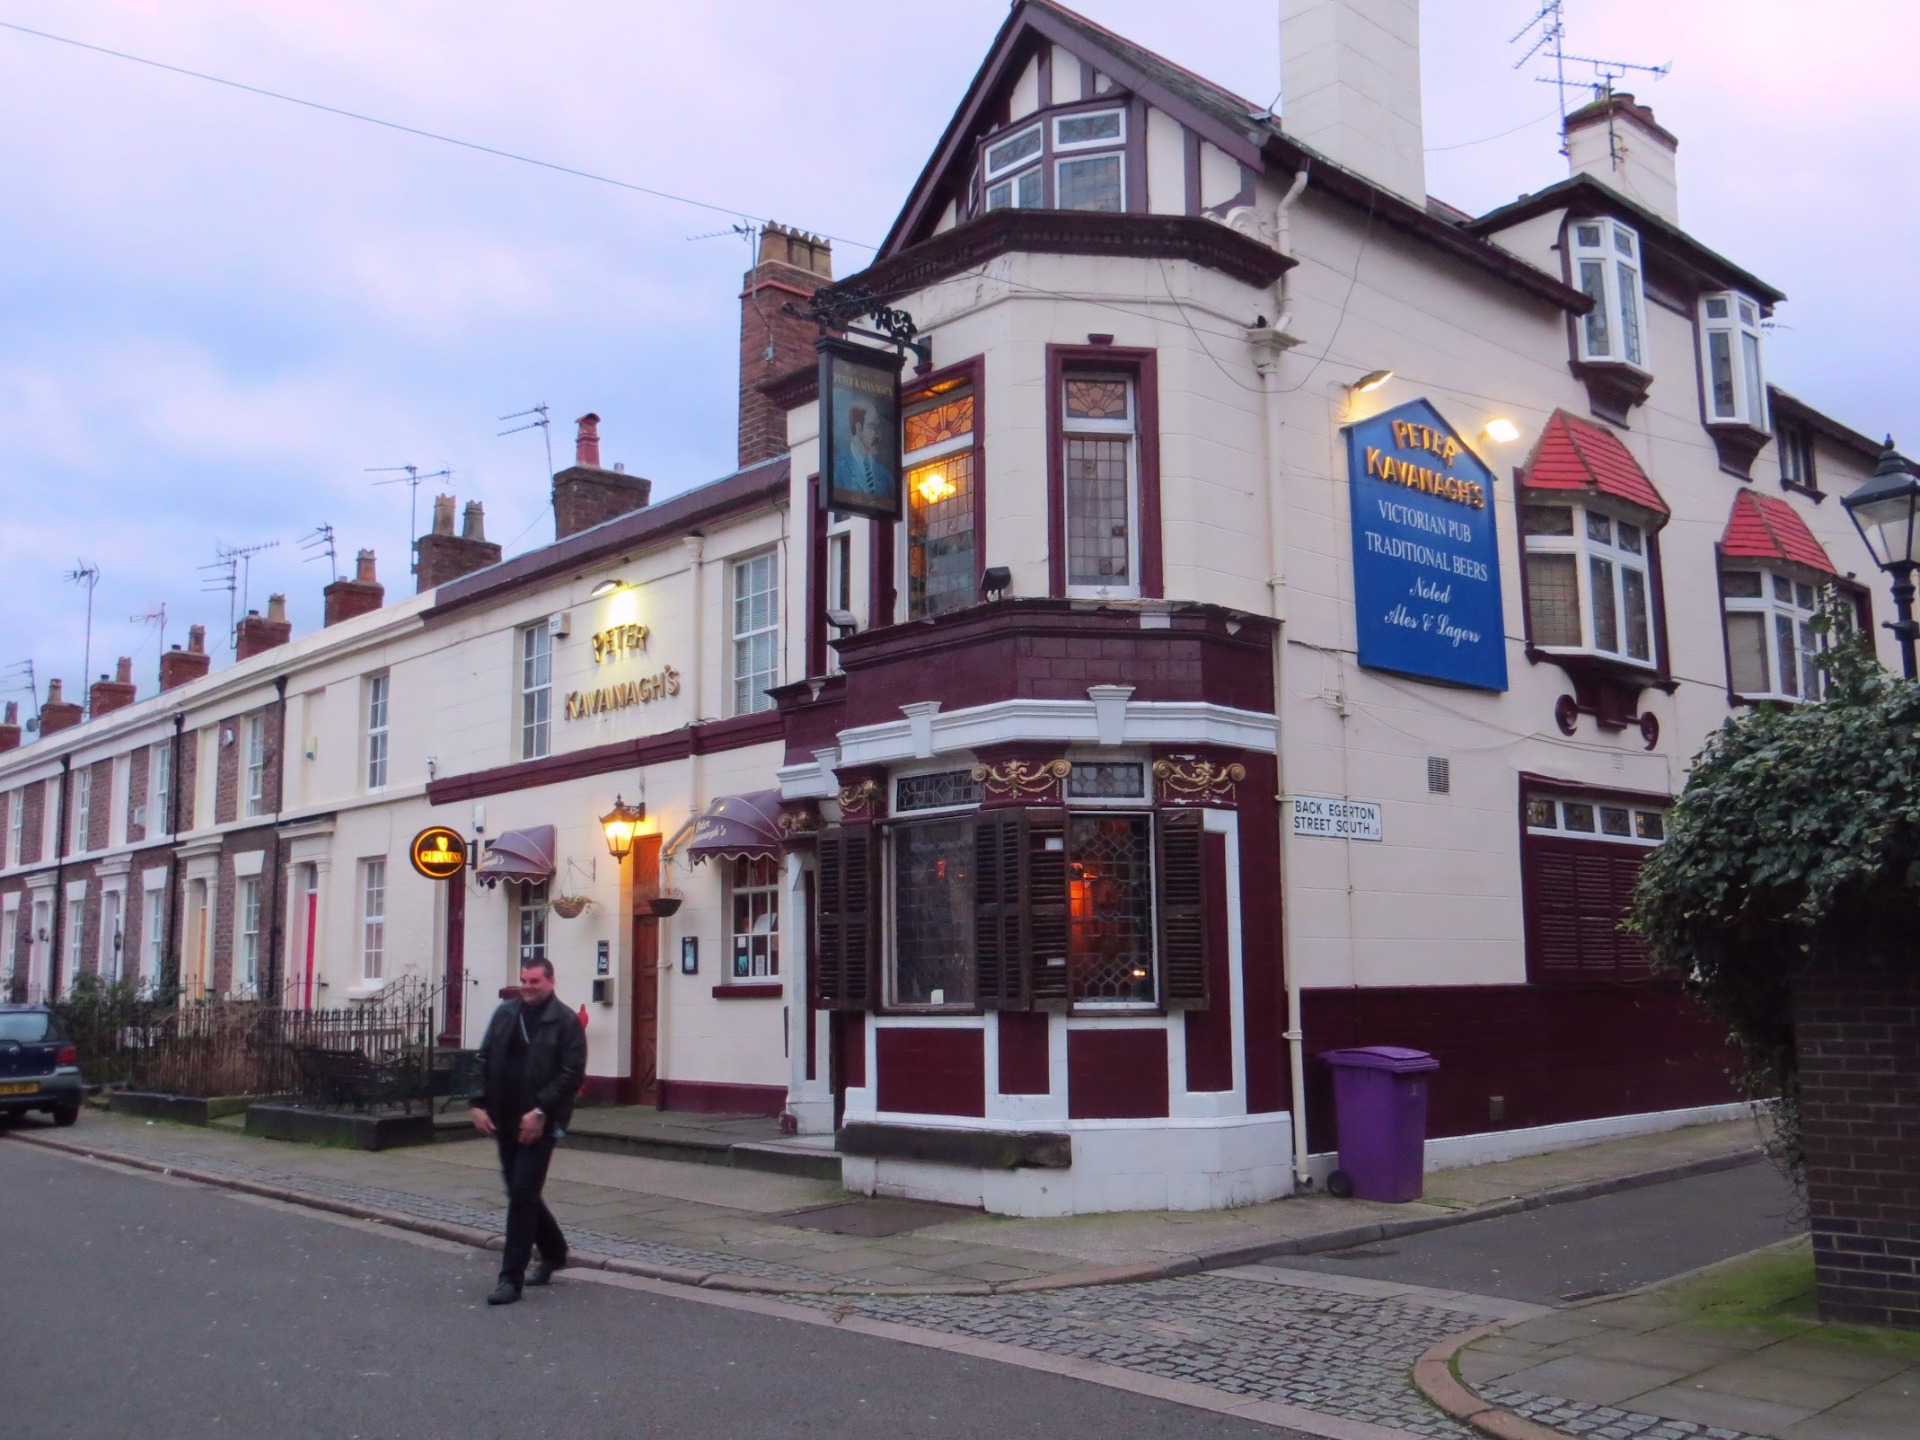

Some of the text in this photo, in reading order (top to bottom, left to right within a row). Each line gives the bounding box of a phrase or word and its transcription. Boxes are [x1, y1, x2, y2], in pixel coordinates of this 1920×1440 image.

[1392, 419, 1459, 467] PETER
[1366, 446, 1485, 509] KAVANAGH'S
[1378, 500, 1471, 543] VICTORIAN PUB
[1365, 531, 1488, 582] TRADITIONAL BEERS
[1409, 576, 1451, 604] Noted
[592, 623, 649, 663] PETER
[1384, 603, 1481, 647] Ales & Lagers
[564, 664, 681, 721] KAVANAGH'S
[1294, 816, 1331, 831] STREET
[1336, 820, 1370, 834] SOUTH
[1295, 800, 1375, 820] BACK EGERTON
[421, 850, 462, 864] GUINNESS
